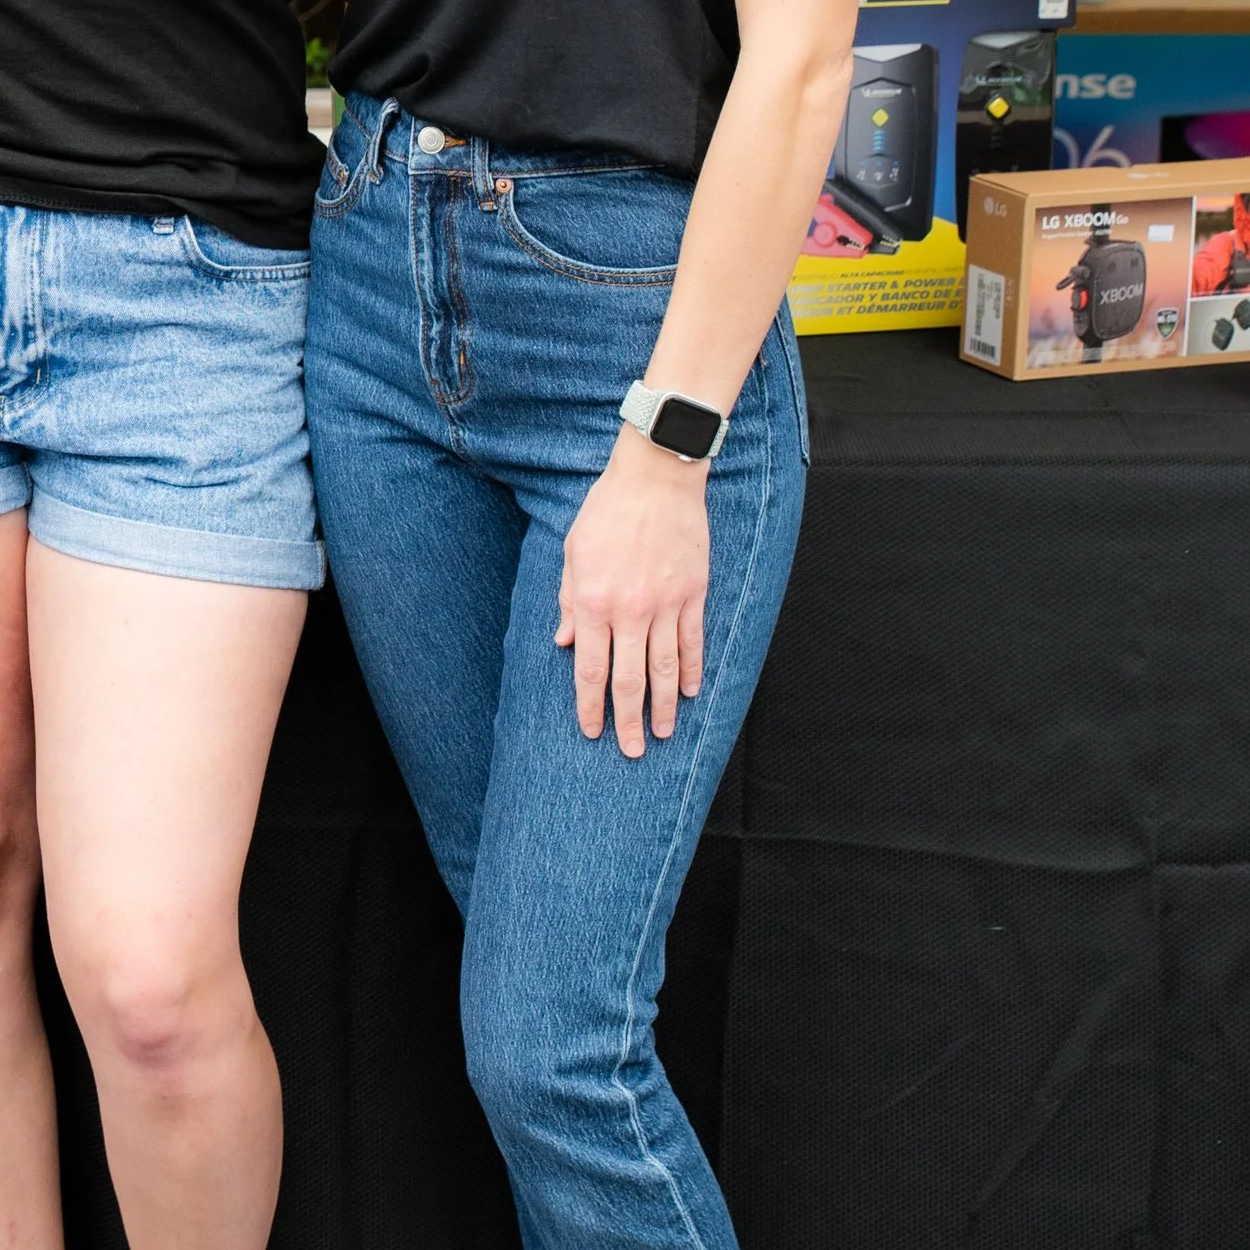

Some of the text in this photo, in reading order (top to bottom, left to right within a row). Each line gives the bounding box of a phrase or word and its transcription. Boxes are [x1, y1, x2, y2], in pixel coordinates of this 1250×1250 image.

[1042, 215, 1061, 230] LG
[1064, 211, 1116, 228] XBOOM
[860, 269, 906, 278] CAPACIDAD
[827, 280, 888, 292] STARTER
[890, 280, 899, 290] &
[903, 277, 956, 288] POWER
[868, 291, 878, 301] Y
[881, 289, 930, 302] BANCO
[933, 288, 950, 299] DE
[1100, 283, 1144, 306] XBOOM
[836, 305, 854, 316] ET
[856, 301, 946, 315] DÉMARREUR
